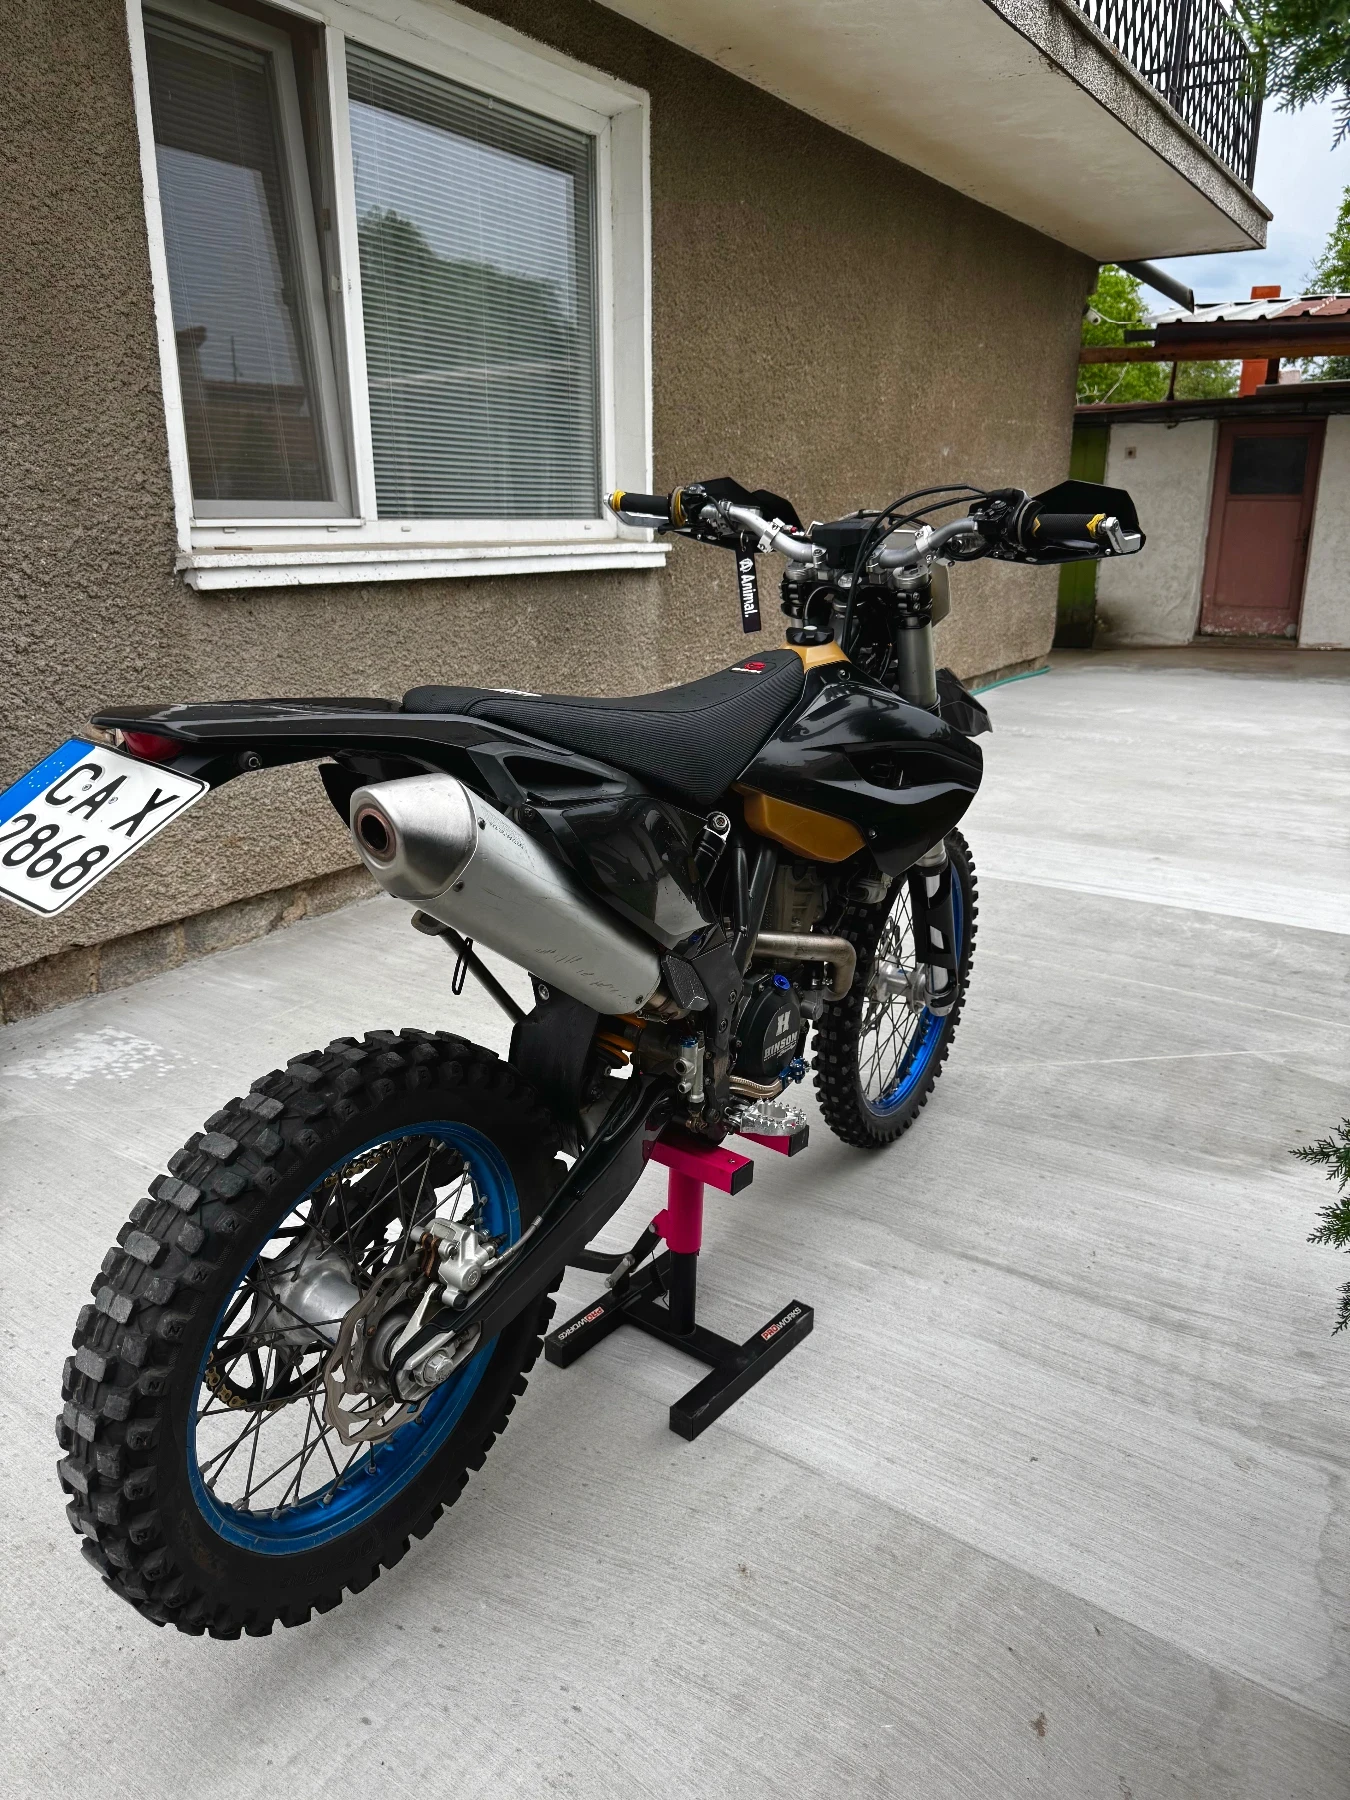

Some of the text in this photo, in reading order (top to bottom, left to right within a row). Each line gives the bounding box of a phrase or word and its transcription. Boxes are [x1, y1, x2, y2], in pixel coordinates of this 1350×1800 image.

[45, 763, 181, 838] CA X
[764, 1031, 798, 1059] HINSON
